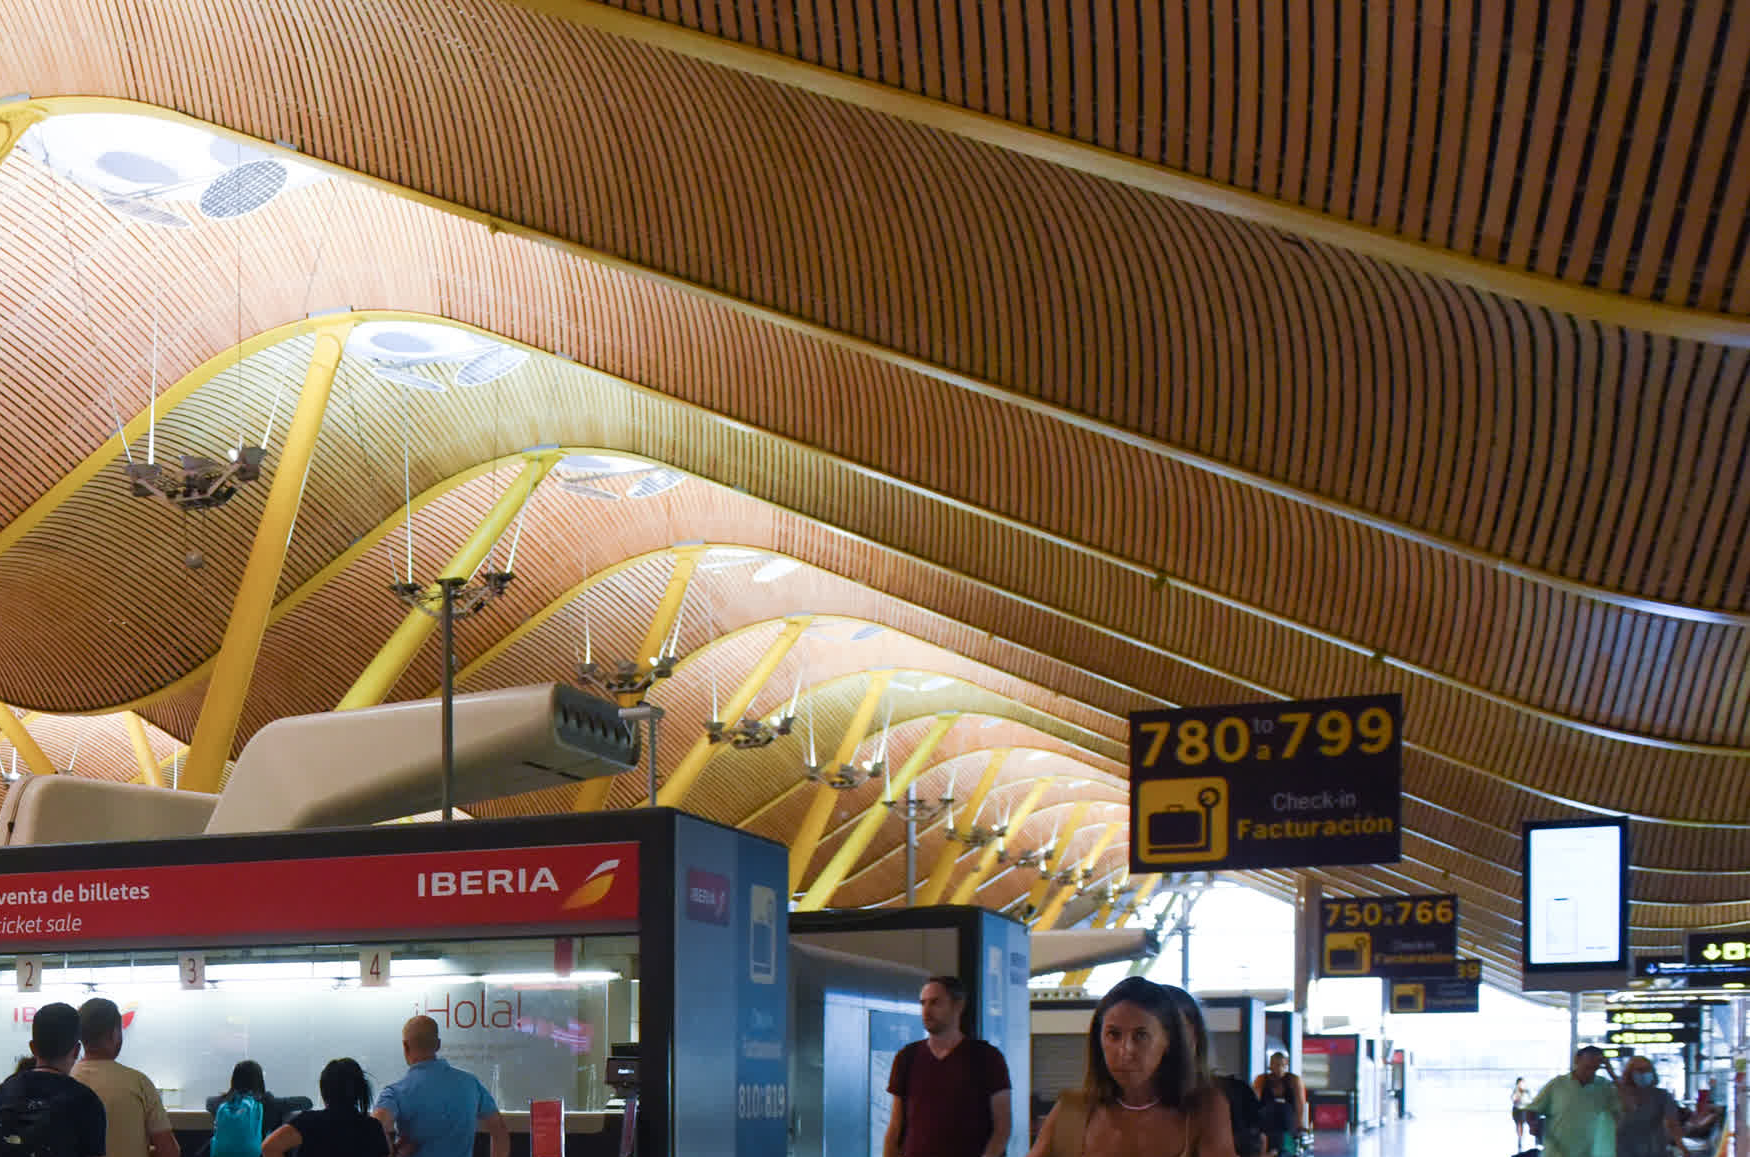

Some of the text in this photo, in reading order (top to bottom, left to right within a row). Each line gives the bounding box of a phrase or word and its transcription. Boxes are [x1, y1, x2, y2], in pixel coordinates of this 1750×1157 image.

[1140, 715, 1250, 767] 780
[1278, 707, 1394, 759] 799
[1272, 790, 1357, 813] Check-in
[1236, 815, 1394, 841] Facturación
[52, 884, 74, 904] de
[78, 882, 151, 903] billetes
[417, 866, 560, 898] IBERIA
[46, 913, 82, 933] sale
[1324, 902, 1382, 927] 750
[1396, 900, 1454, 925] 766
[24, 961, 35, 987] 2
[187, 960, 198, 985] 3
[369, 953, 382, 980] 4
[737, 1083, 786, 1120] 810 819
